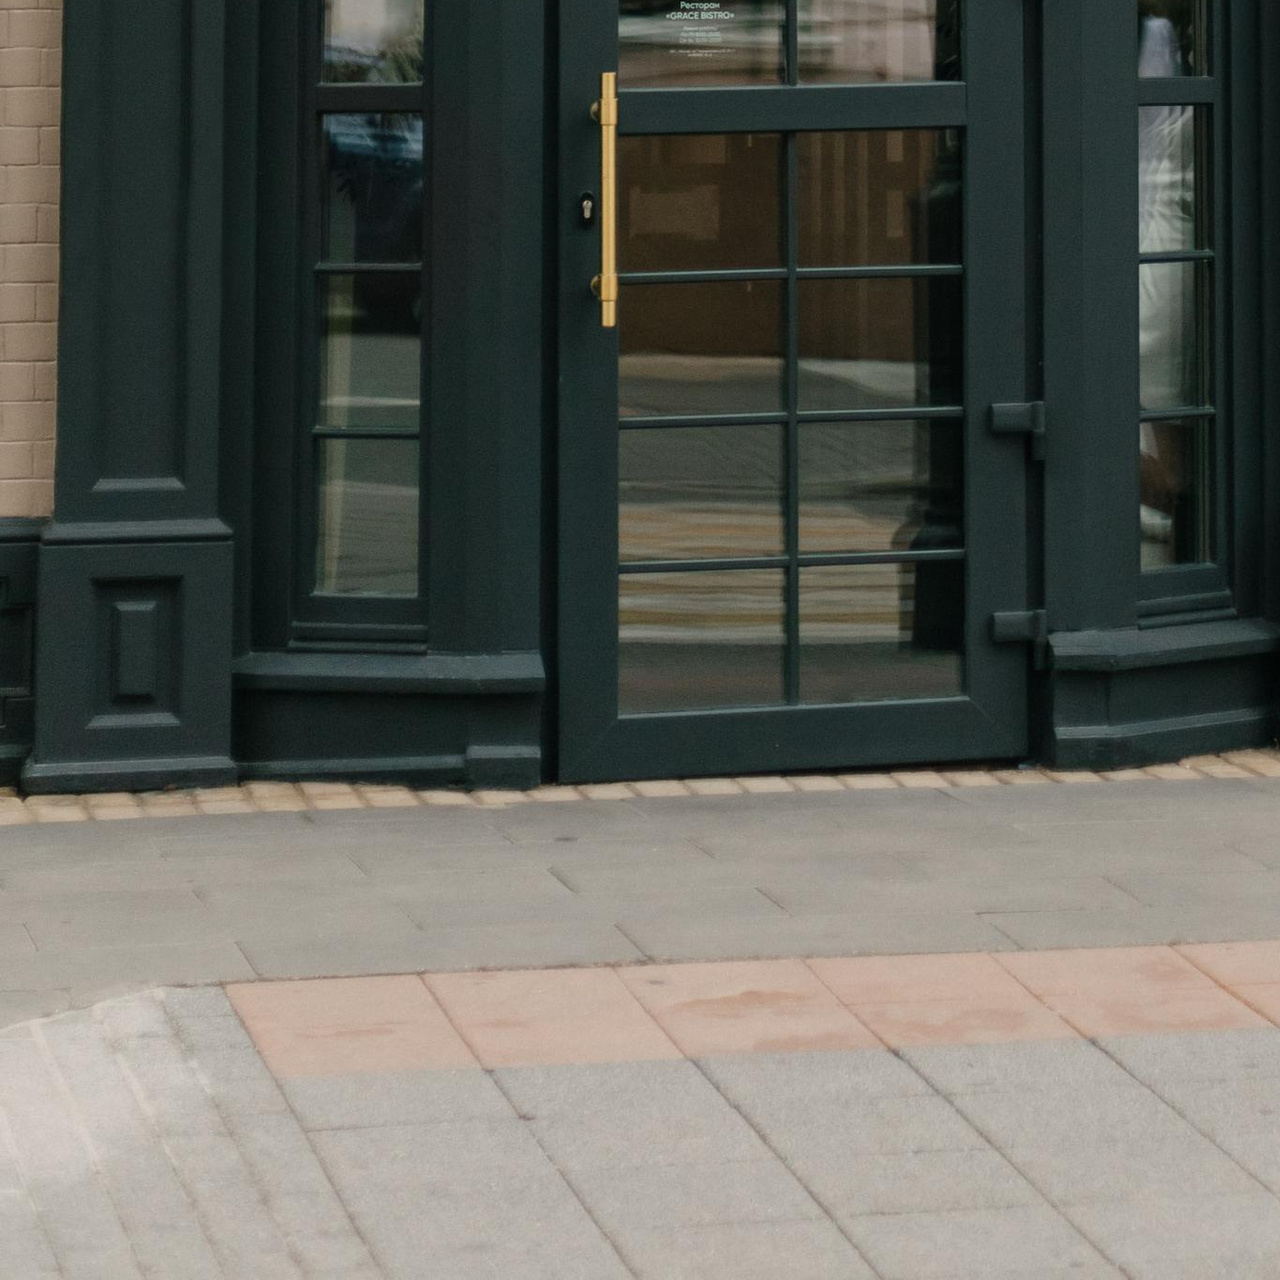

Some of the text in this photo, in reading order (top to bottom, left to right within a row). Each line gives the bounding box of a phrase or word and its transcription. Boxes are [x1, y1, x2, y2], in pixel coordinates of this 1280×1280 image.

[680, 1, 720, 11] Ресторан
[665, 11, 735, 20] «GRACE BISTRO»
